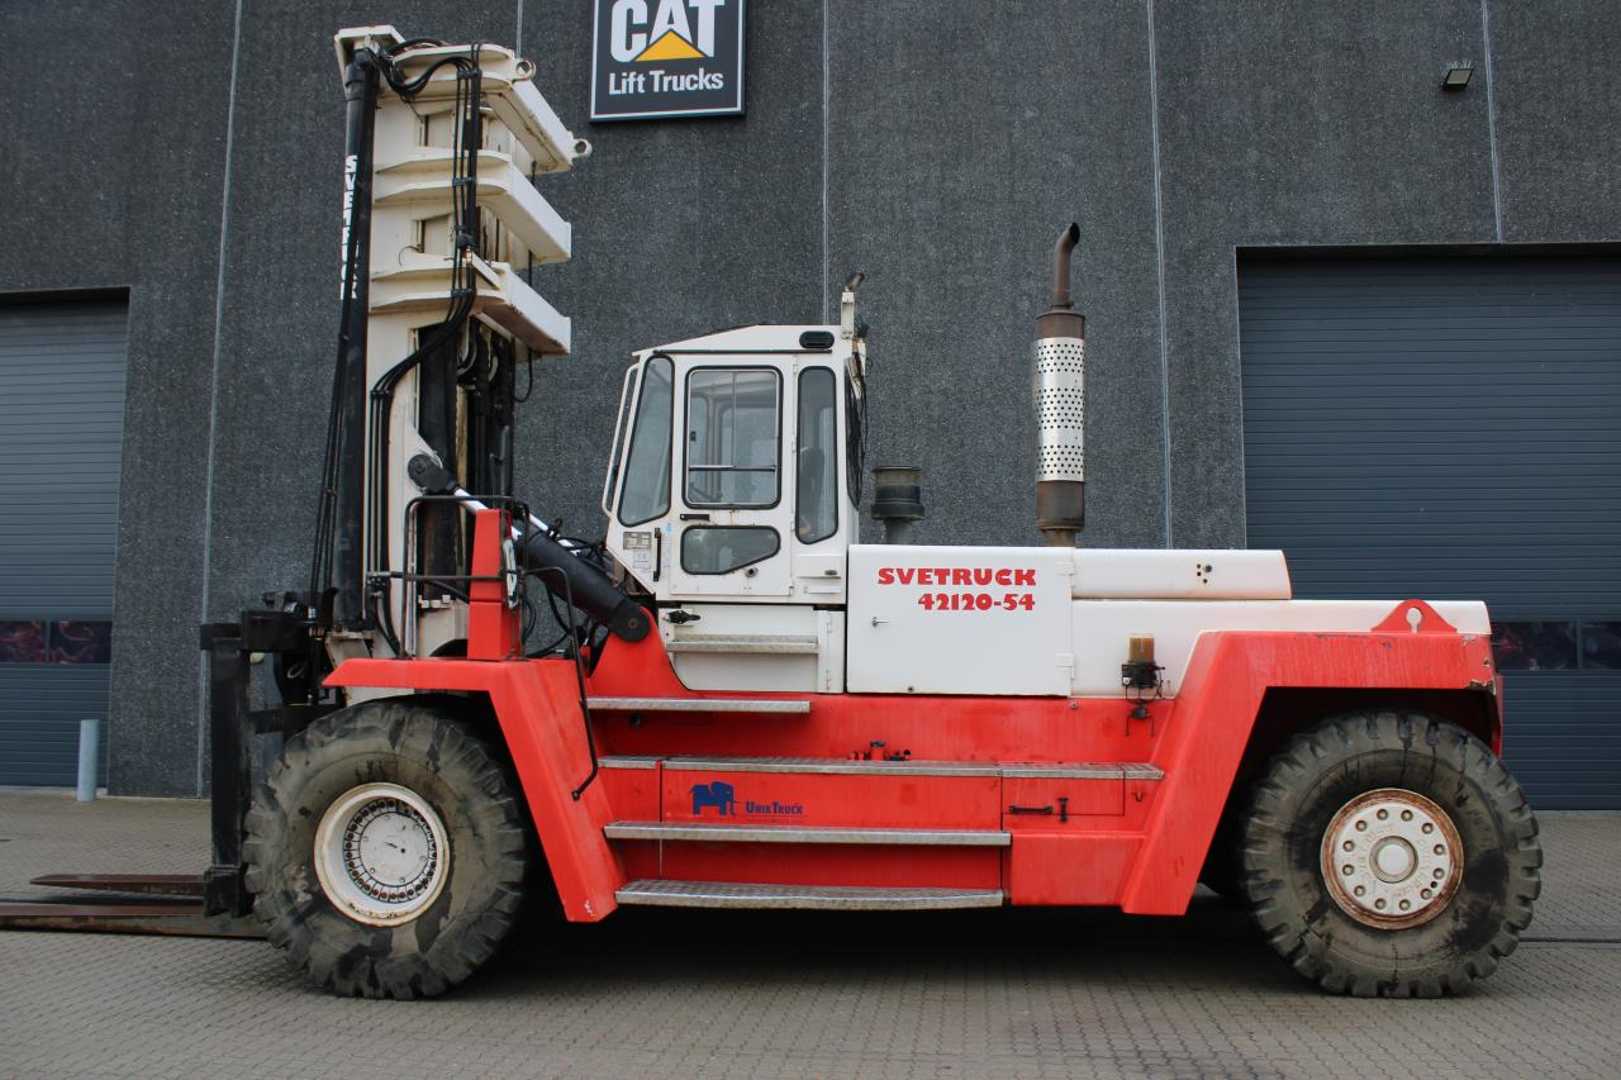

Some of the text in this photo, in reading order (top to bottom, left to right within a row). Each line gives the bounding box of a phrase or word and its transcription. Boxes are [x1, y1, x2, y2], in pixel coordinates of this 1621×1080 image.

[610, 0, 725, 62] CAT
[608, 67, 724, 95] Lift Trucks
[878, 567, 1037, 586] SVETRUCK
[918, 592, 1036, 611] 42120-54
